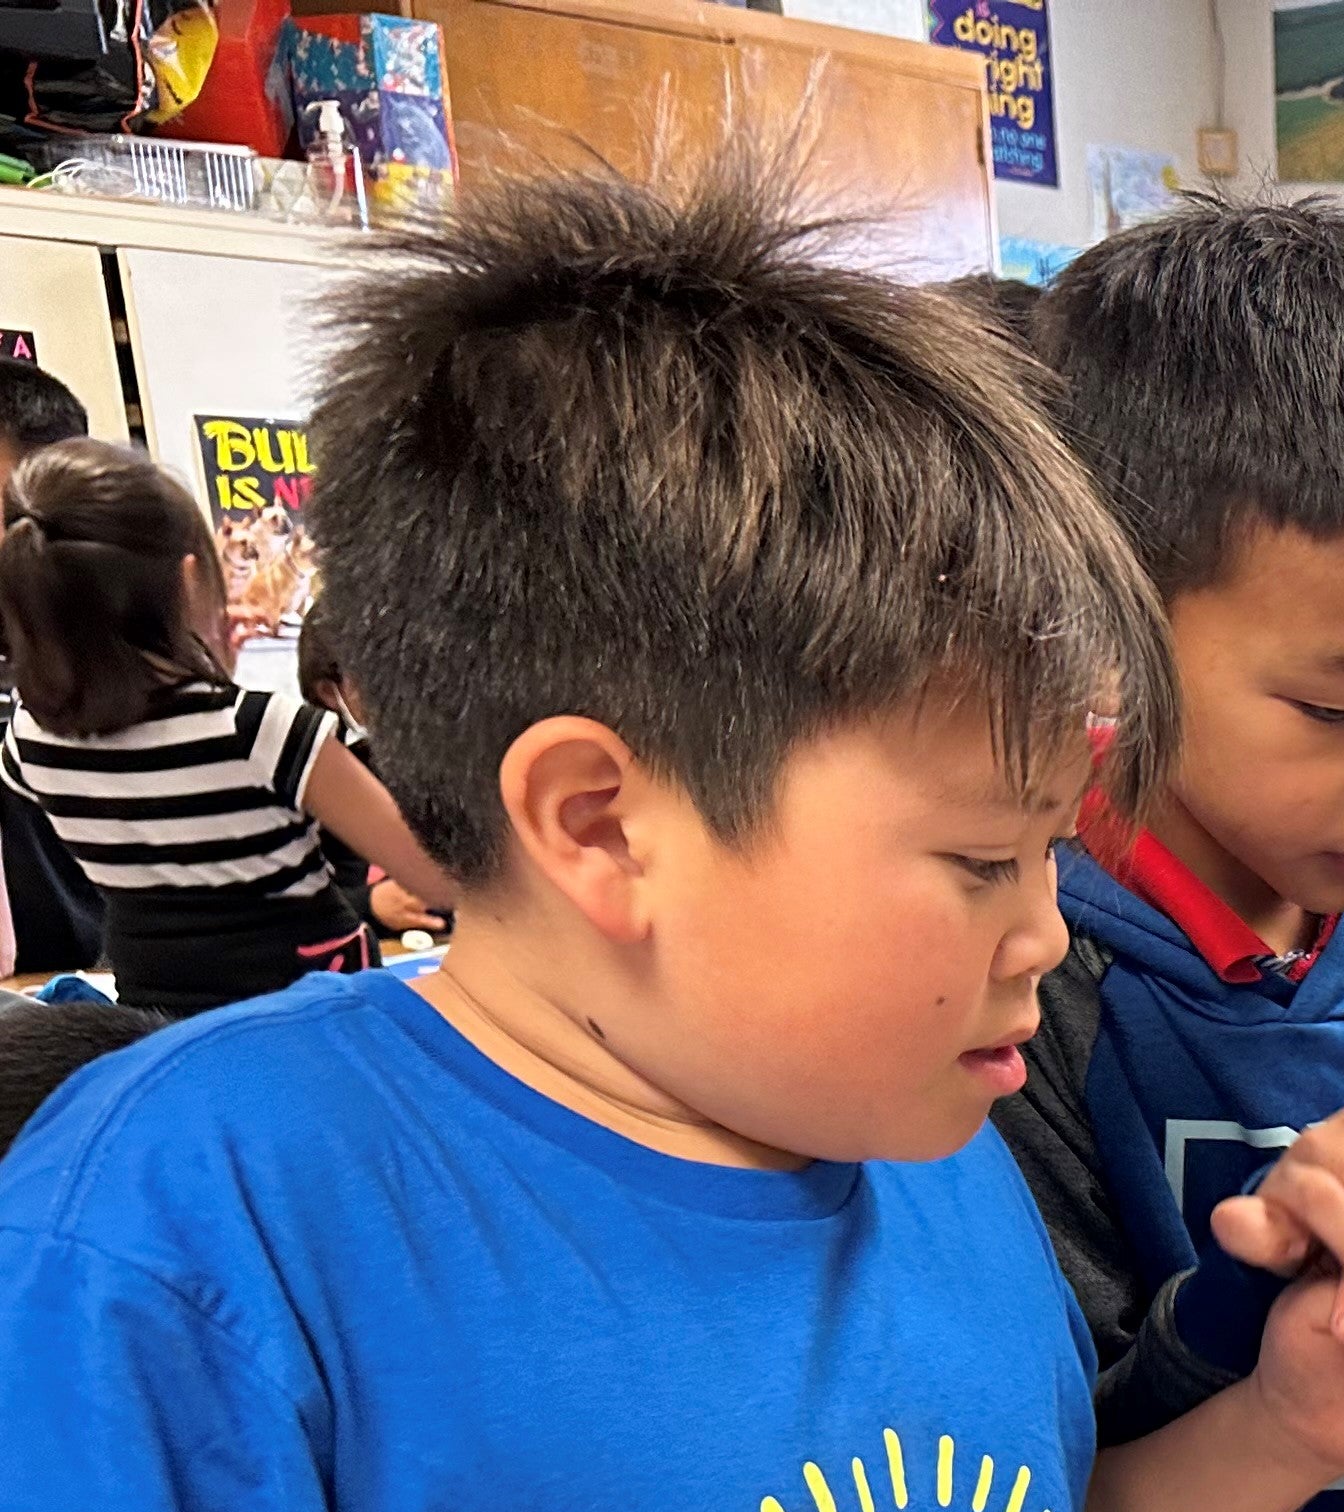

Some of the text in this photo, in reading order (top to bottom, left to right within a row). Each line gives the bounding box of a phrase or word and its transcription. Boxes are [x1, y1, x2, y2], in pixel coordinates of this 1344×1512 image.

[953, 8, 1038, 62] doing
[985, 51, 1044, 93] ight
[988, 82, 1035, 130] ing
[202, 419, 318, 475] BUL
[215, 474, 267, 511] IS
